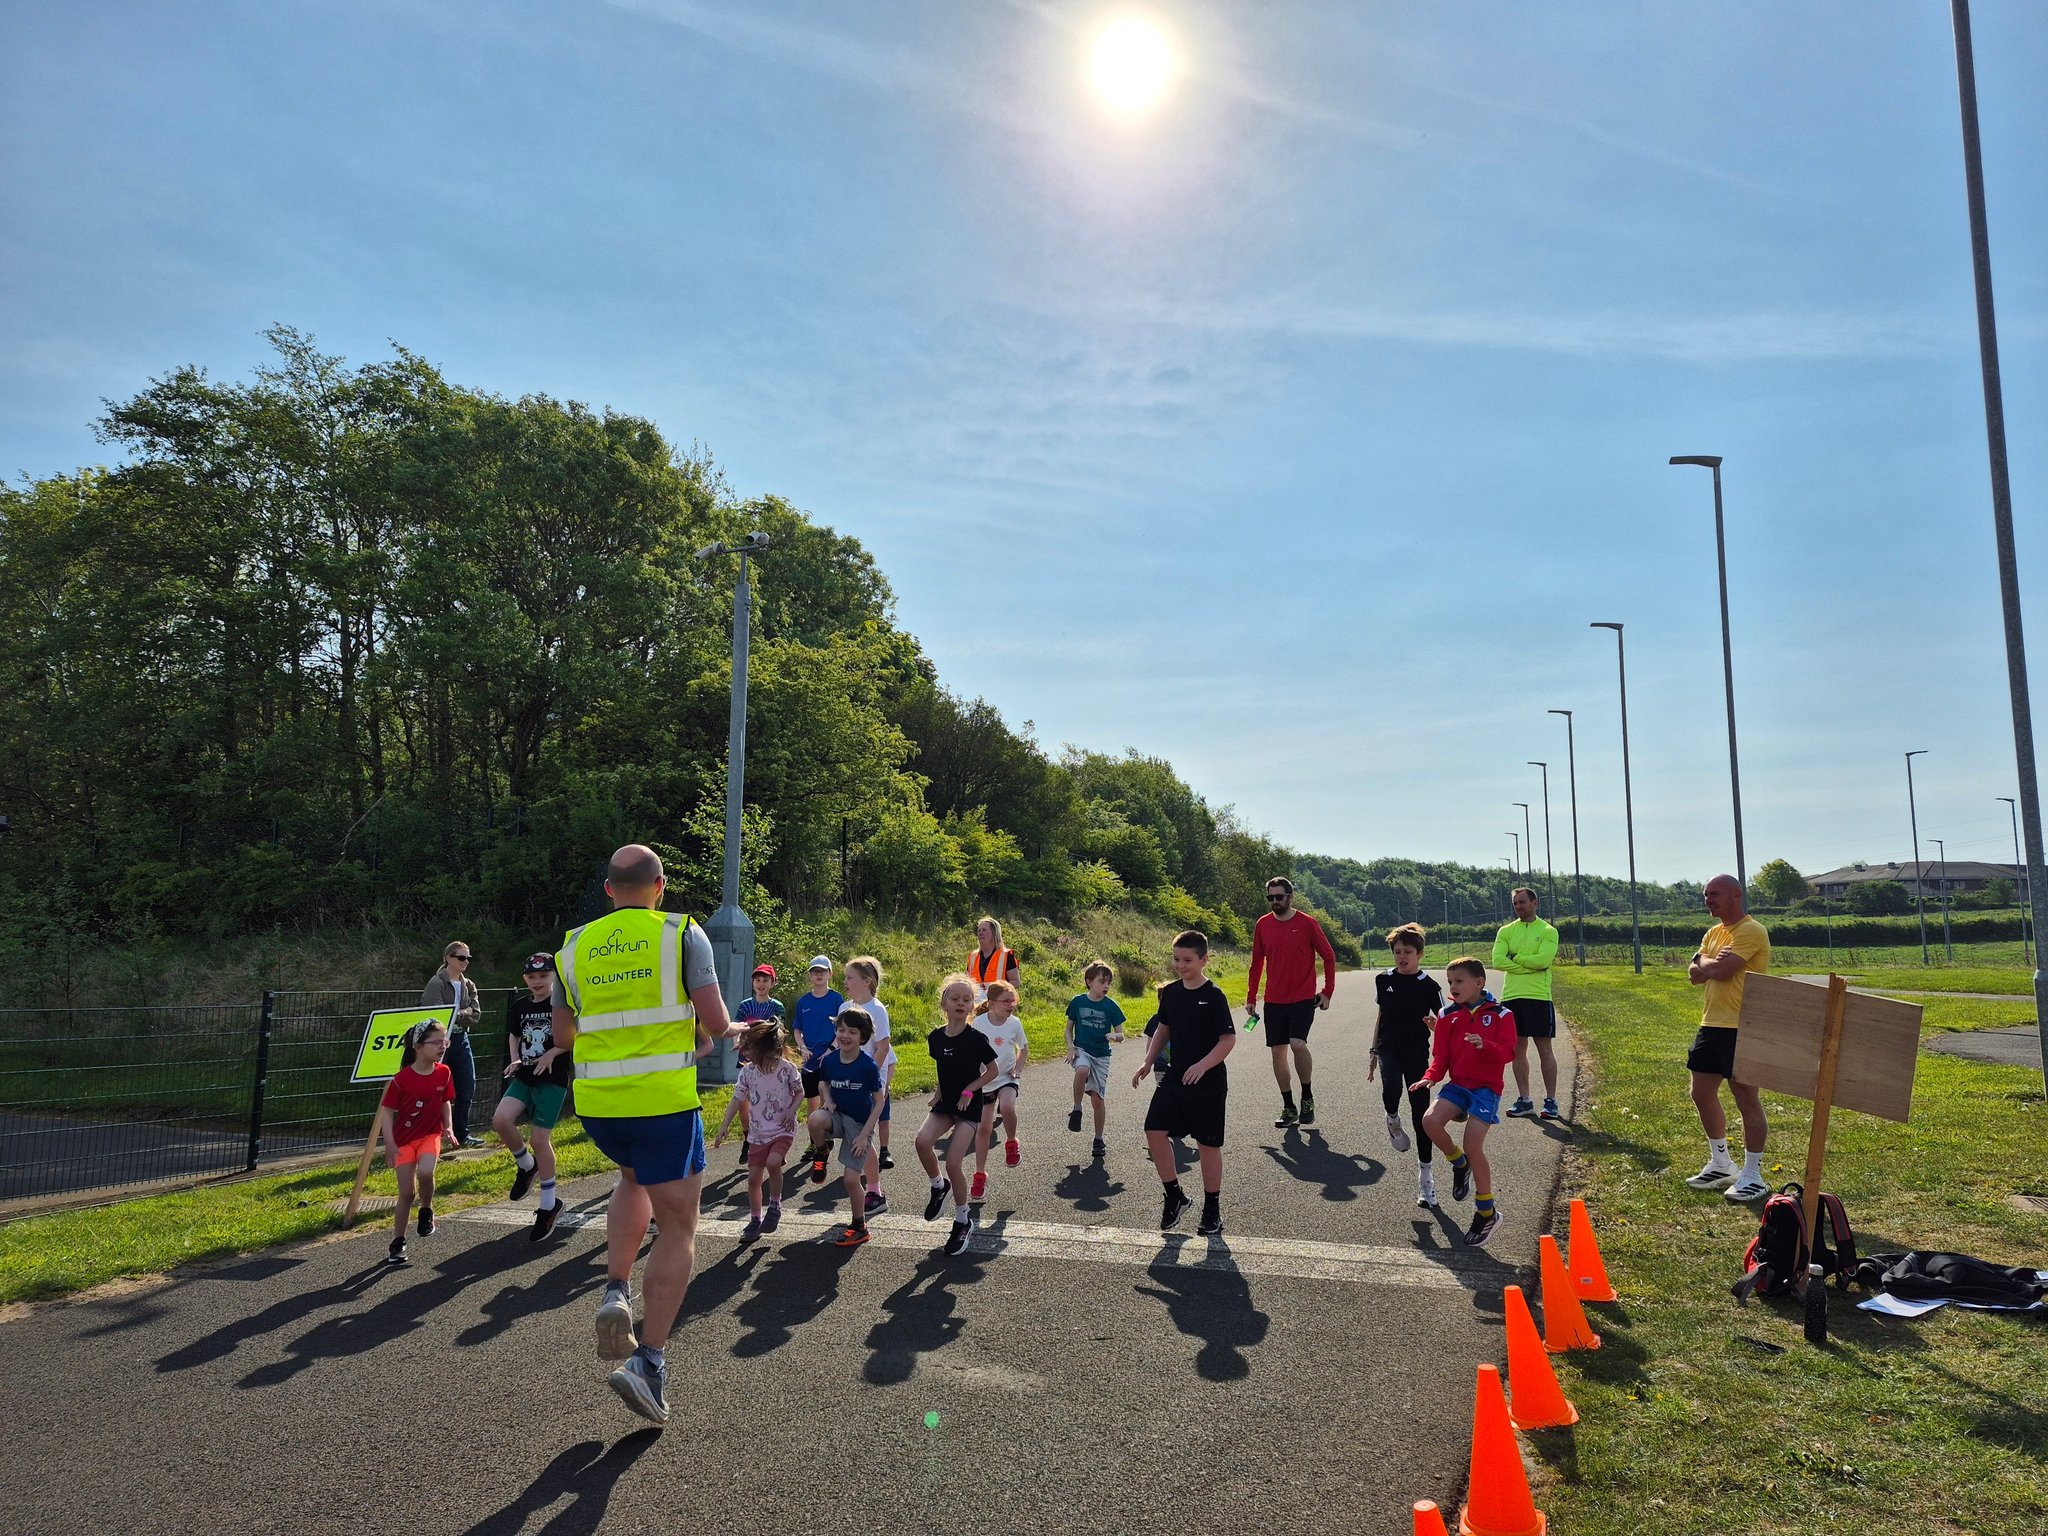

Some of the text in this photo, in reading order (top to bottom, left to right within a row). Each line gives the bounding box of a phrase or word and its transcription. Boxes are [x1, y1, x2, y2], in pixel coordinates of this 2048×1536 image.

[589, 929, 649, 961] parkrun
[586, 969, 653, 985] VOLUNTEER
[372, 1034, 405, 1051] STA
